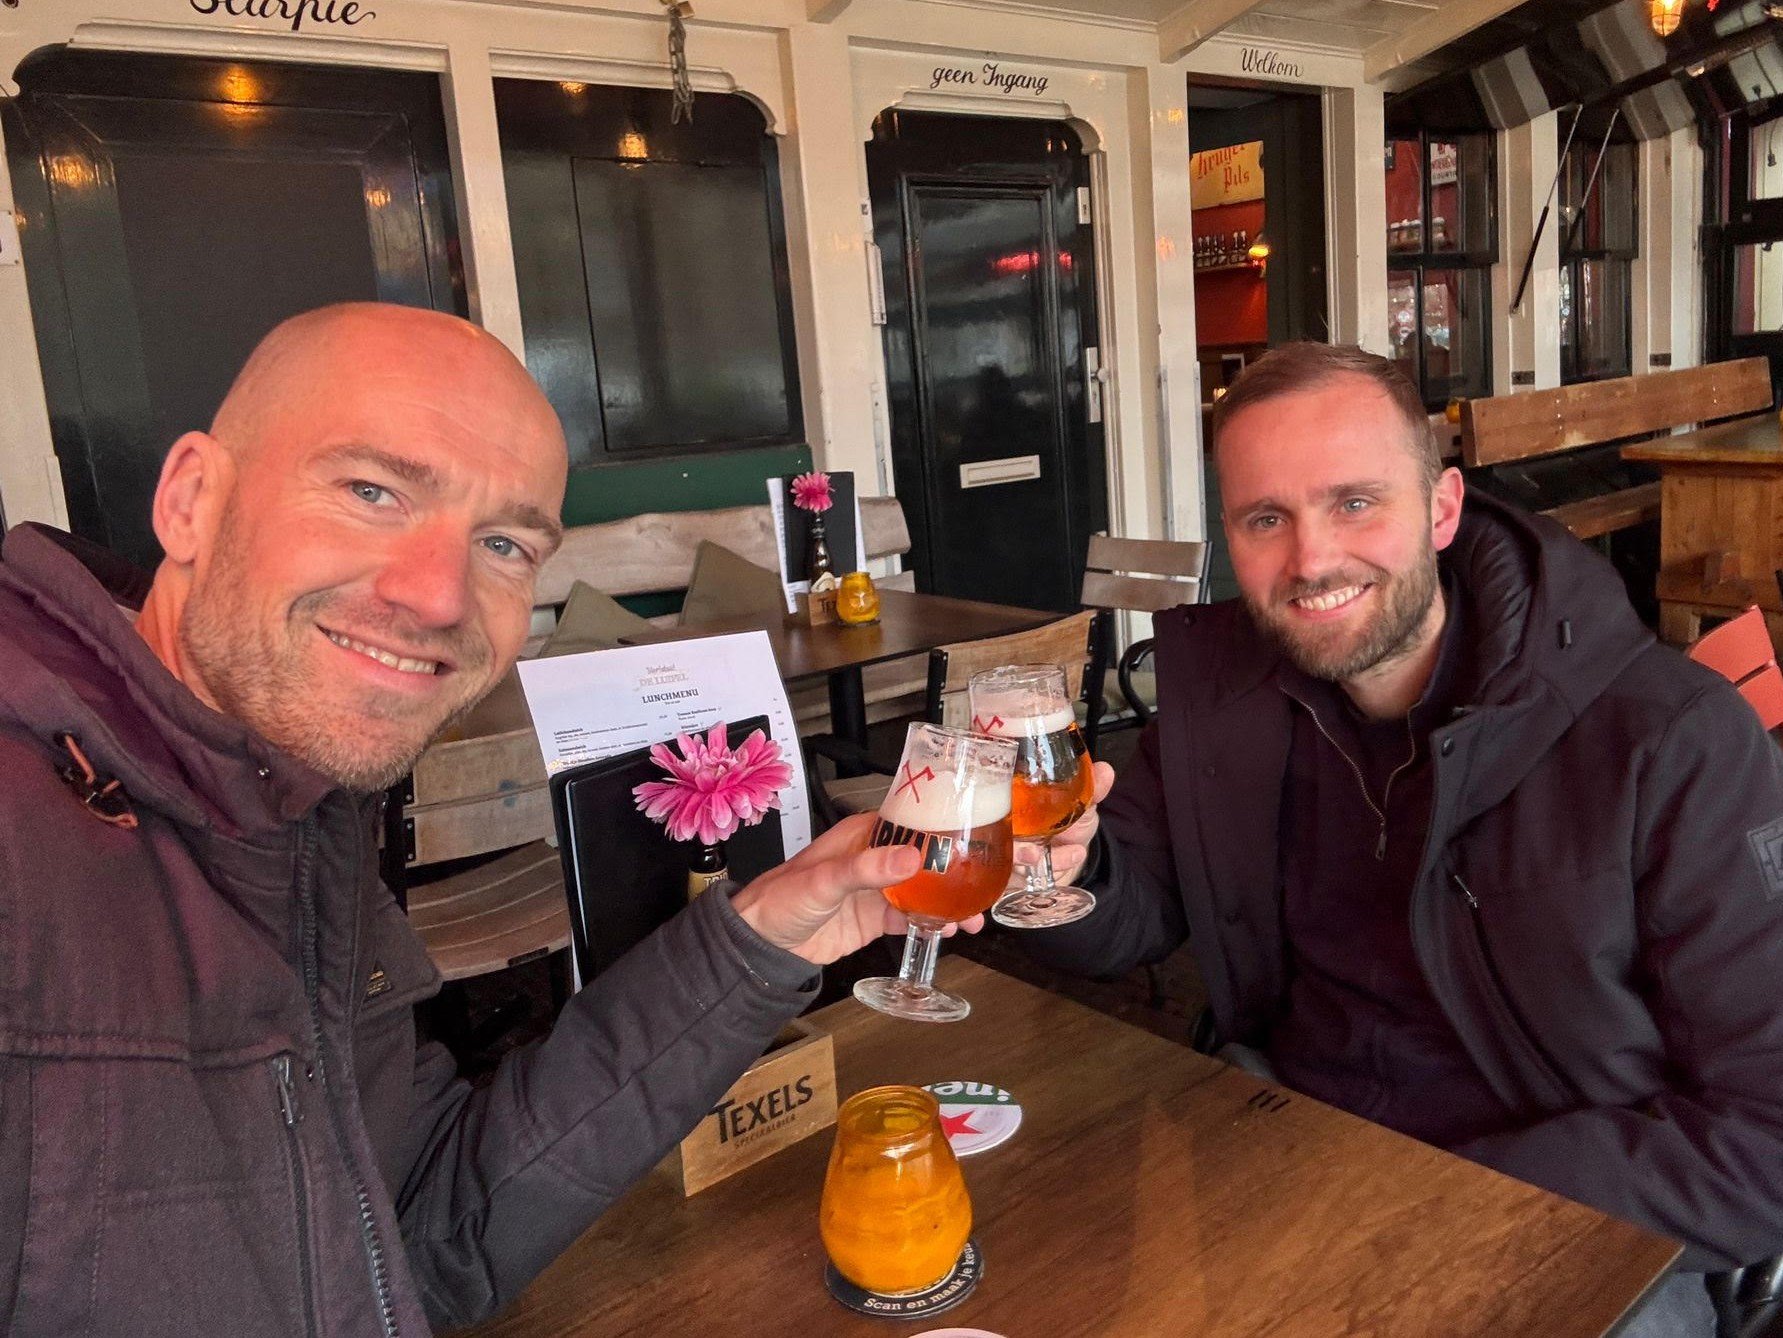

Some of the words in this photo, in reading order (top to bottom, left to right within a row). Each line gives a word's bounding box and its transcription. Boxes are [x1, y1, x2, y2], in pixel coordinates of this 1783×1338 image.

[1241, 48, 1304, 78] Welkom
[930, 67, 979, 89] geen
[982, 63, 1048, 96] Ingang
[1223, 165, 1250, 193] Pils
[641, 688, 699, 704] LUNCHMENU
[707, 1074, 813, 1145] TEXELS
[863, 1297, 902, 1310] Scan
[906, 1299, 926, 1309] en
[930, 1278, 966, 1303] maak
[958, 1266, 973, 1279] je
